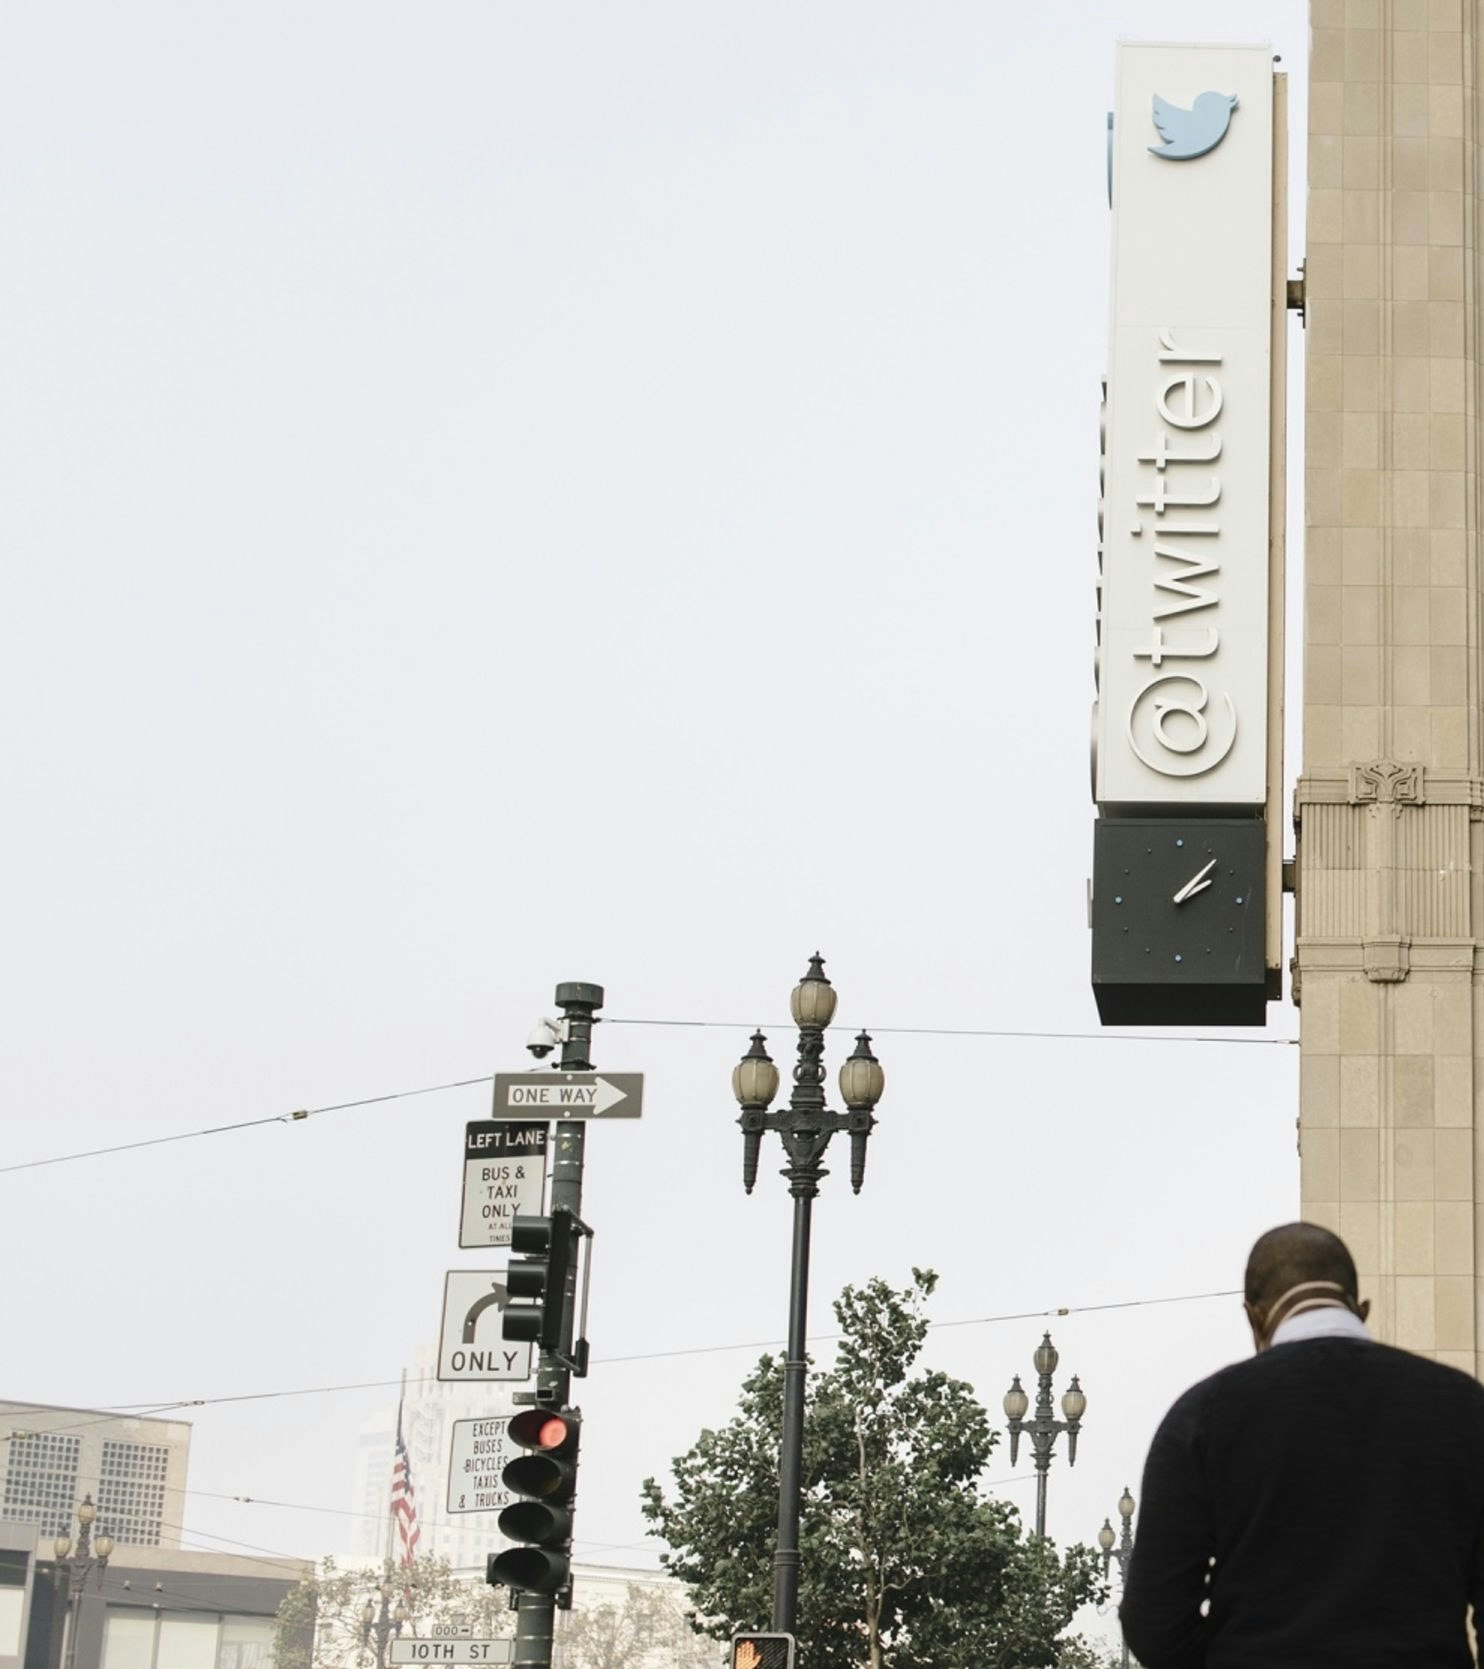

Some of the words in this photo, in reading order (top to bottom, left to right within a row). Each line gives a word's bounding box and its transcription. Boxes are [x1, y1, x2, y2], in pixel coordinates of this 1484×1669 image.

[1126, 326, 1238, 778] @twitter
[512, 1088, 550, 1103] ONE
[559, 1088, 598, 1103] WAY
[467, 1132, 502, 1149] LEFT
[505, 1130, 545, 1147] LANE
[482, 1166, 510, 1181] BUS
[515, 1165, 525, 1180] &
[487, 1184, 518, 1199] TAXI
[482, 1203, 521, 1218] ONLY
[451, 1350, 518, 1372] ONLY
[472, 1421, 506, 1437] EXCEPT
[473, 1438, 503, 1455] BUSES
[473, 1474, 498, 1490] TAXIS
[458, 1494, 466, 1509] &
[475, 1491, 510, 1507] TRUCKS
[411, 1644, 454, 1659] 10TH
[469, 1644, 491, 1659] ST
